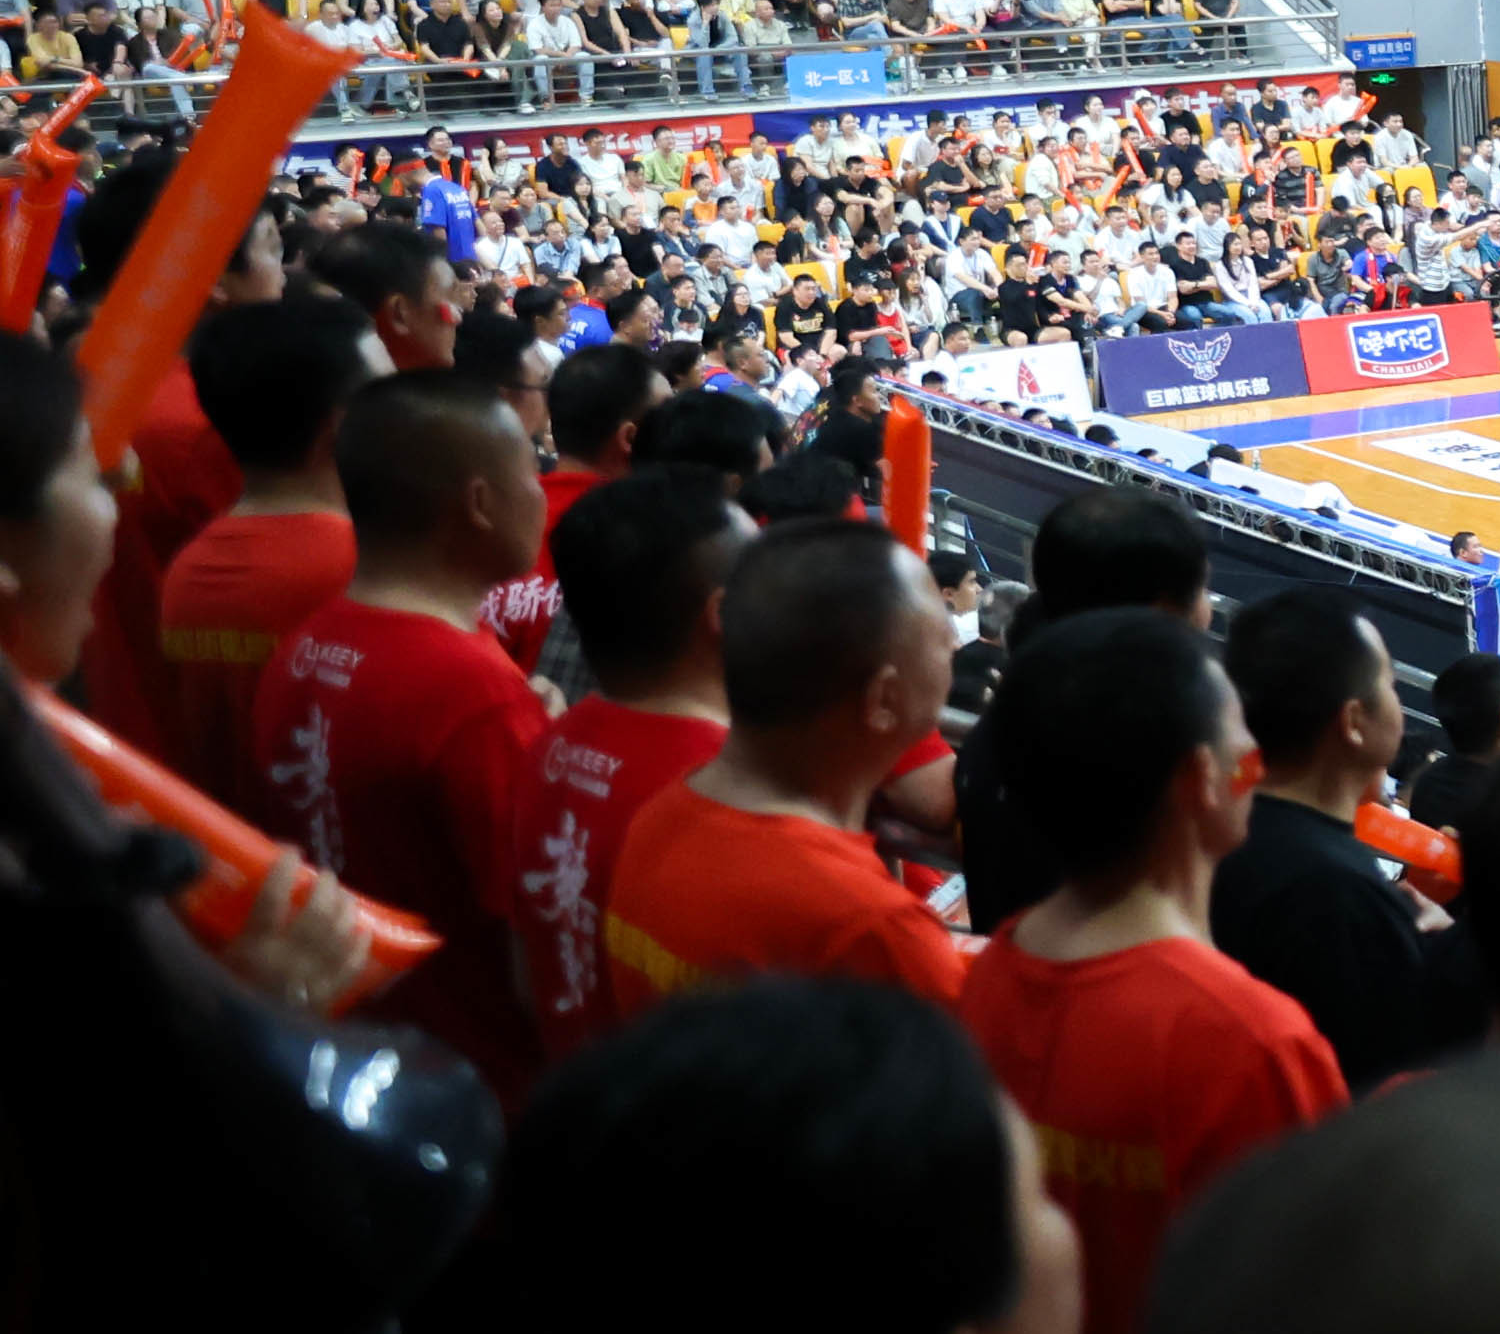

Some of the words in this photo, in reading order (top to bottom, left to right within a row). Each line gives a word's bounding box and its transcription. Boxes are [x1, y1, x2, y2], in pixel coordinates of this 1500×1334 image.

[804, 68, 870, 87] 北一区-1
[1357, 326, 1434, 357] 馋虾记
[1372, 358, 1434, 373] CHANXIAJI
[1145, 378, 1271, 407] 巨鹏篮球俱乐部
